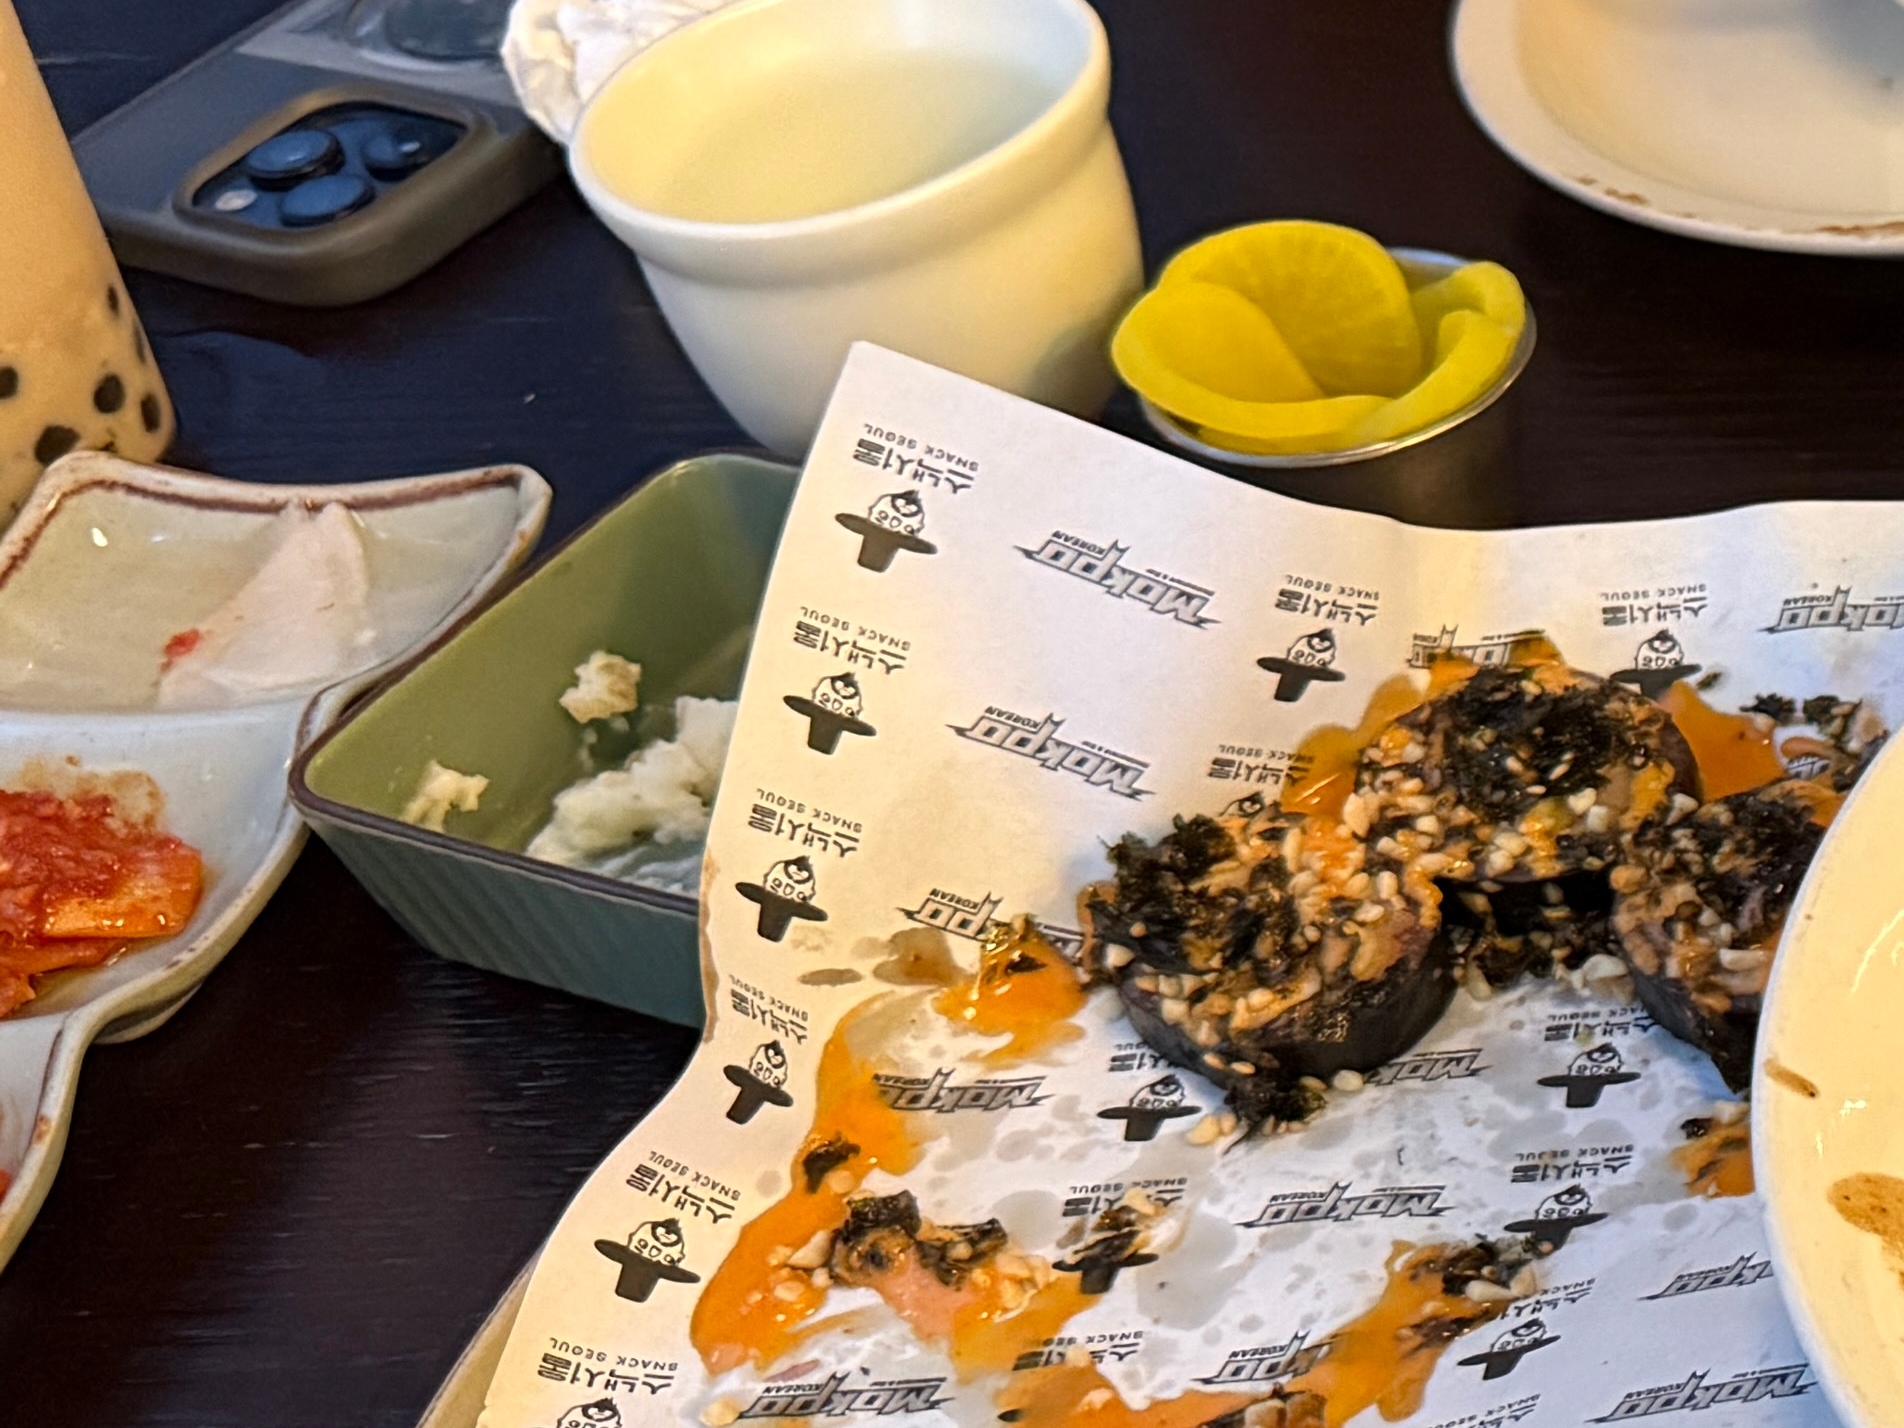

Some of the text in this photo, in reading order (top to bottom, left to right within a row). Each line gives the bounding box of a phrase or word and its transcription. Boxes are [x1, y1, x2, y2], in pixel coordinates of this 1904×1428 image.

[853, 438, 975, 494] 스낵서울
[863, 423, 979, 472] SNACK SEOUL
[1051, 530, 1107, 556] KOREAN
[1014, 539, 1222, 630] Mokpo
[1600, 584, 1707, 601] SNACK SEOUL
[793, 620, 907, 675] 스낵서울
[800, 606, 911, 651] SNACK SEOUL
[984, 705, 1040, 729] KOREAN
[944, 712, 1156, 802] Mokpo
[1218, 744, 1263, 758] SEOUL
[748, 803, 859, 858] 스낵서울
[757, 788, 862, 833] SNACK SEOUL
[1578, 1143, 1634, 1157] SNACK
[626, 1163, 735, 1224] 스낵서울
[648, 1151, 741, 1201] SNACK SEOUL
[1269, 1191, 1328, 1203] KOREAN
[1234, 1181, 1457, 1229] Mokpo
[549, 1337, 678, 1372] SNACK SEOUL
[1085, 1330, 1144, 1344] SNACK
[537, 1353, 674, 1395] 스낵서울
[738, 1371, 955, 1420] Mokpo
[763, 1383, 826, 1395] KOREAN
[1584, 1368, 1818, 1424] Mokpo
